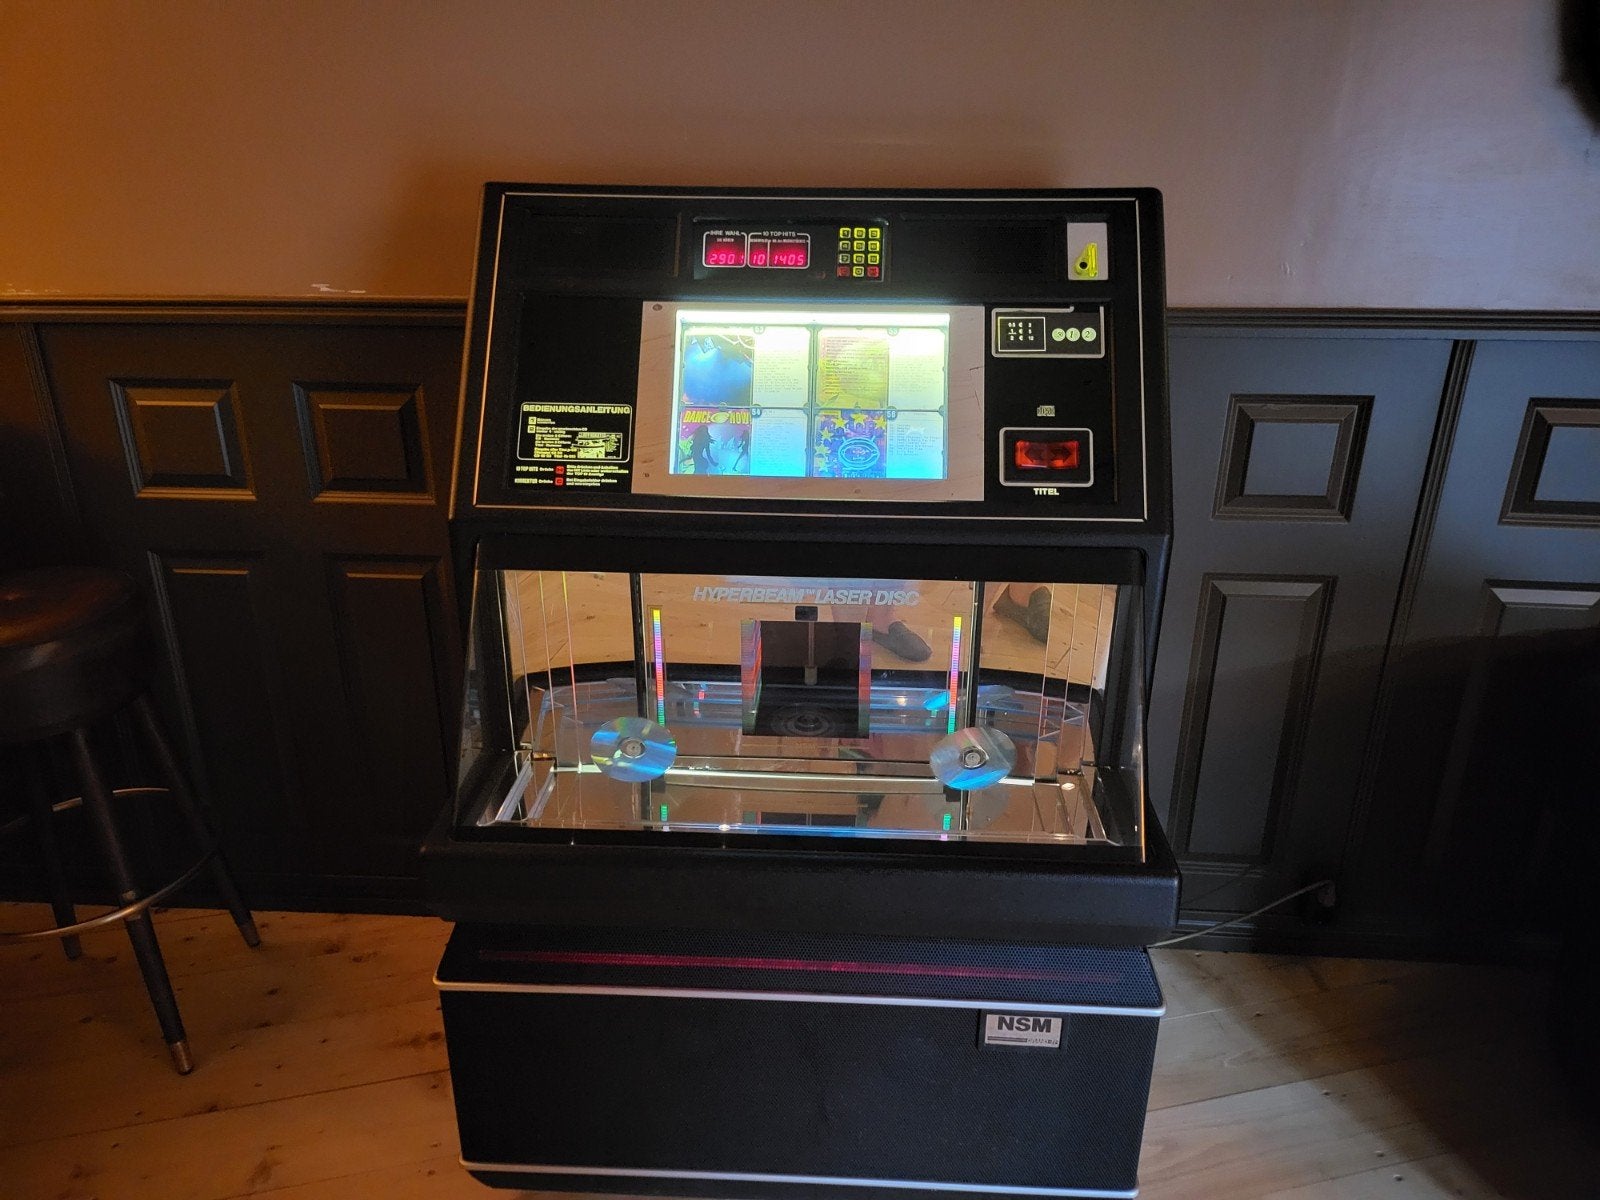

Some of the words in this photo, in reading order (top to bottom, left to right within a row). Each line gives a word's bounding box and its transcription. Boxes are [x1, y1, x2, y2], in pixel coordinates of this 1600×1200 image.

[752, 254, 766, 265] 10
[774, 254, 804, 265] 1405
[523, 405, 630, 414] BEDIENUNGSANLEITUNG
[683, 410, 711, 423] DANCE
[1033, 488, 1059, 496] TITEL
[815, 589, 872, 605] LASER
[875, 591, 920, 606] DISC
[998, 1016, 1052, 1033] NSM
